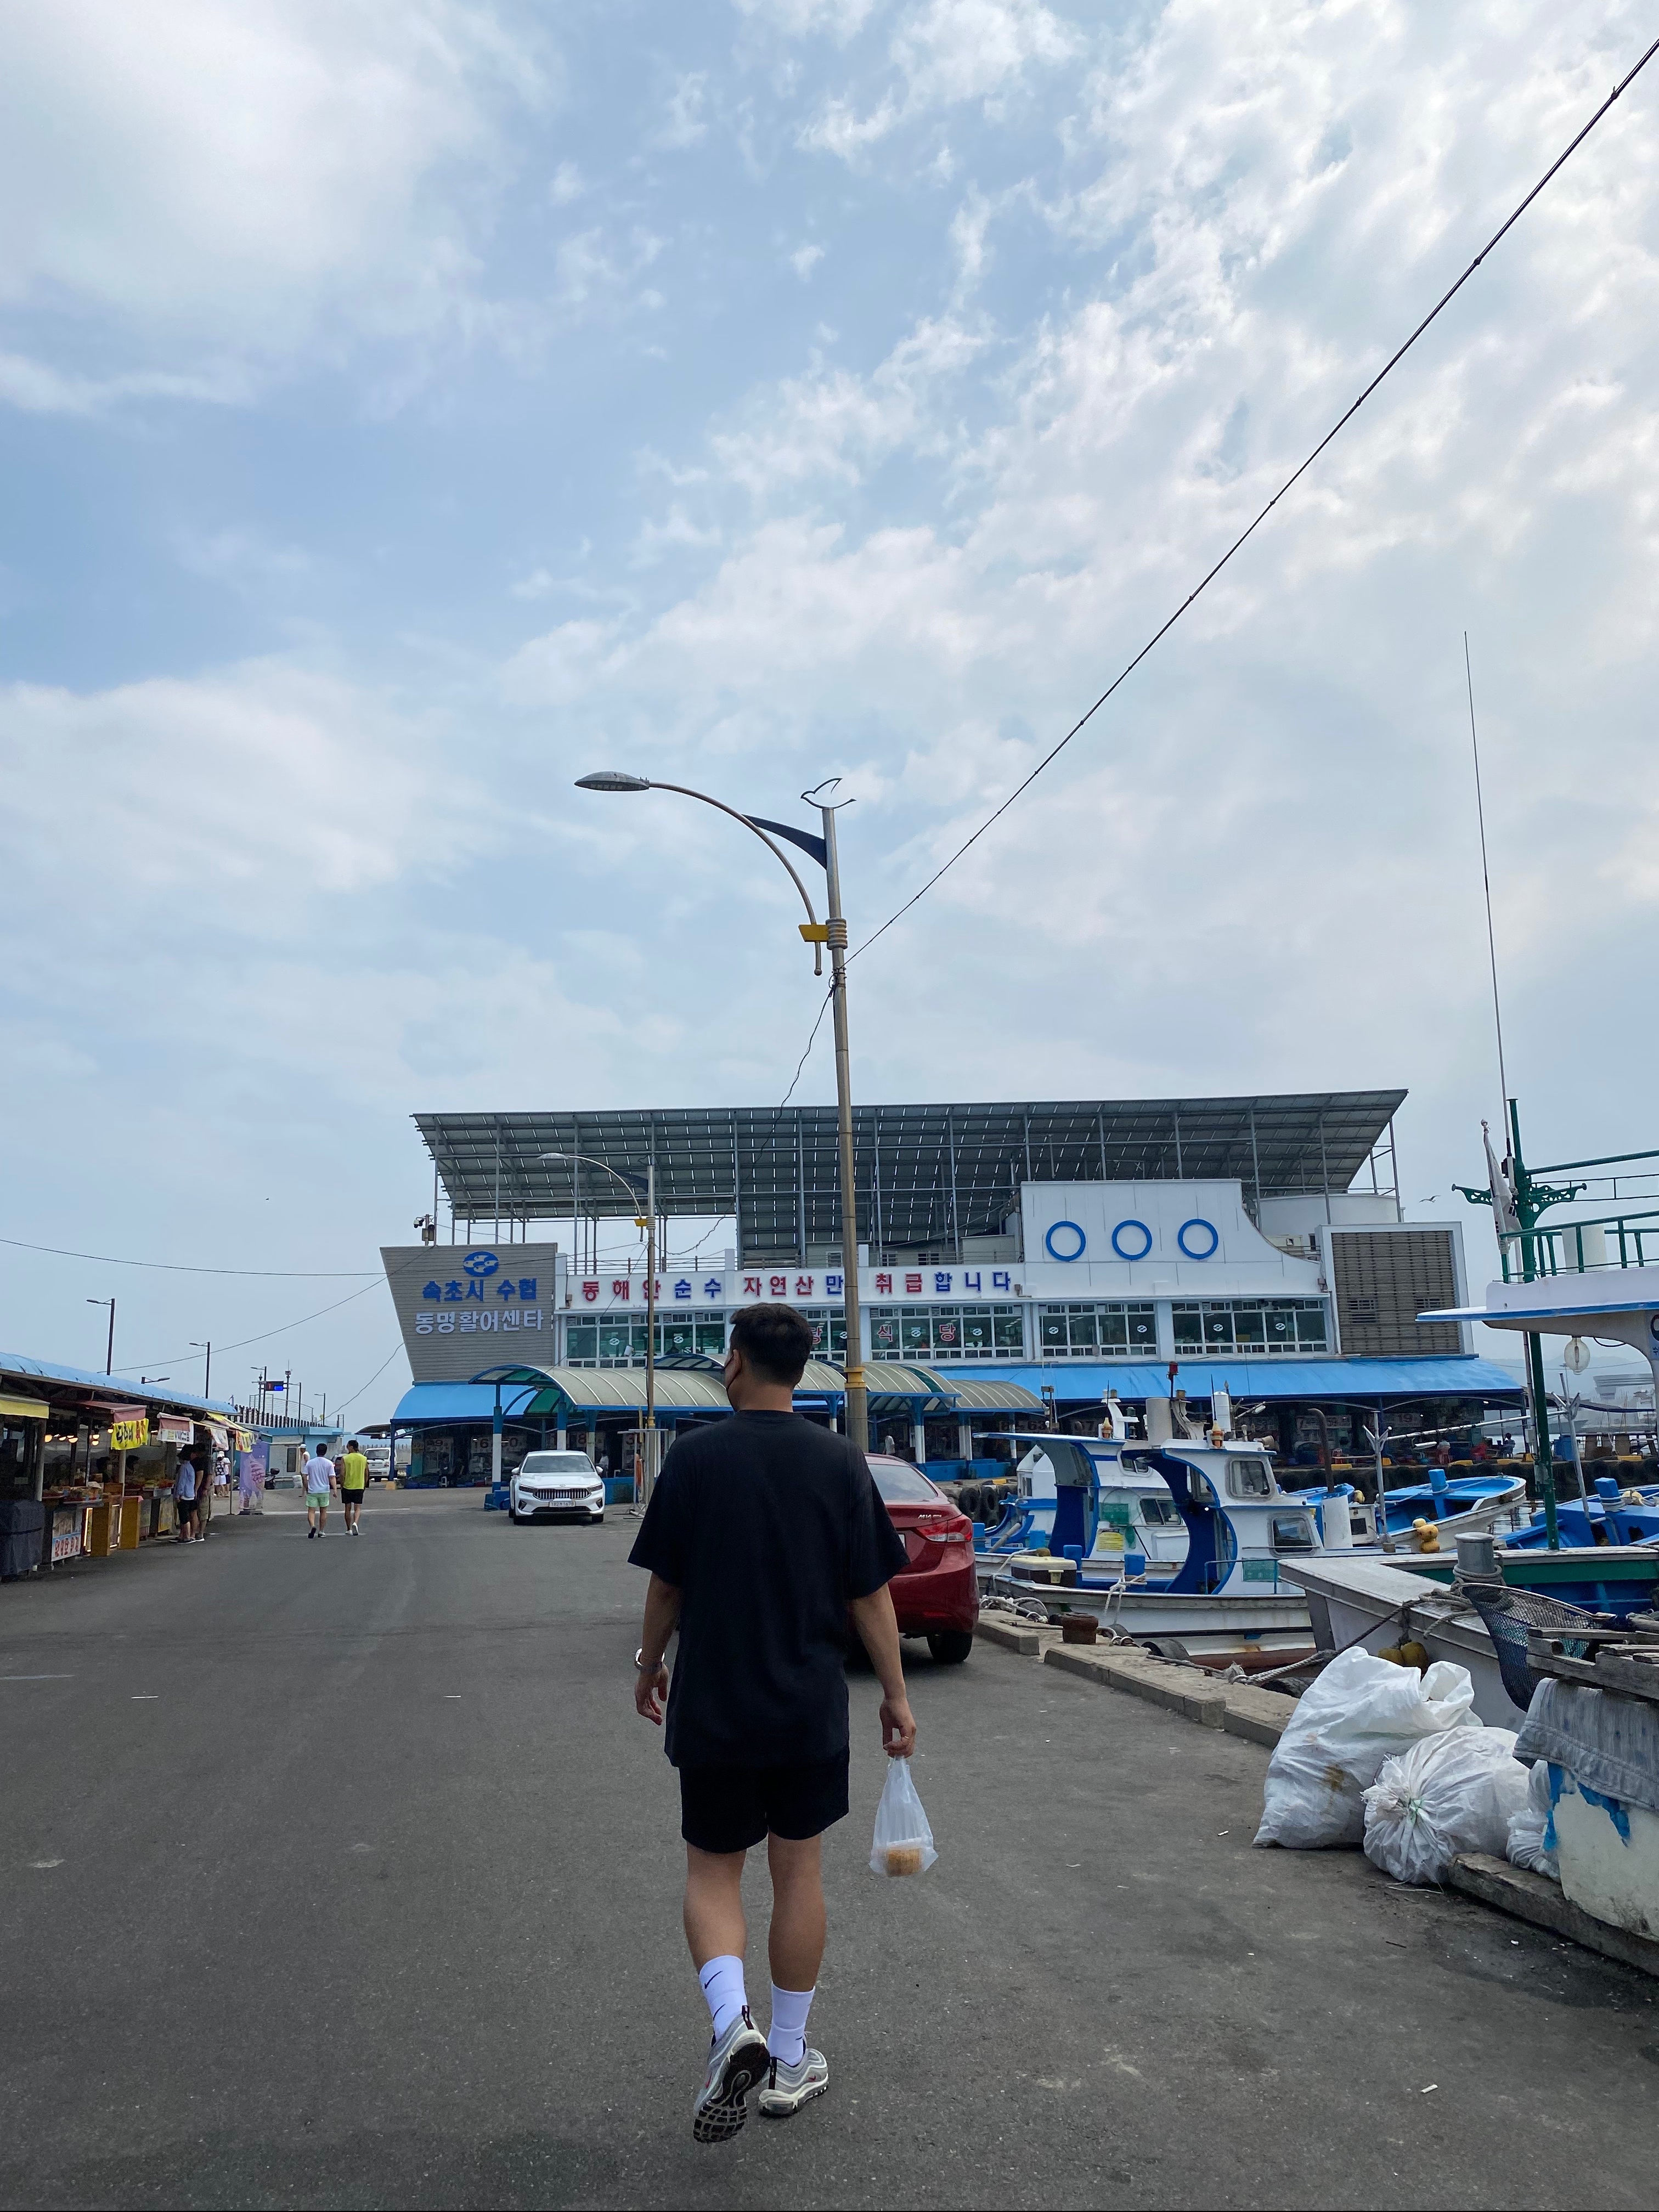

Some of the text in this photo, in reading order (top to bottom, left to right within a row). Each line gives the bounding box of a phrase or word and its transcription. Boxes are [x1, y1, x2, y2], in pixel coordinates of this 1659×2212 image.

[422, 1278, 537, 1302] 속초시 수협
[582, 1279, 662, 1302] 동해안
[675, 1278, 721, 1299] 순수
[876, 1271, 1011, 1294] 취급합니다
[415, 1309, 544, 1334] 동명활어센타
